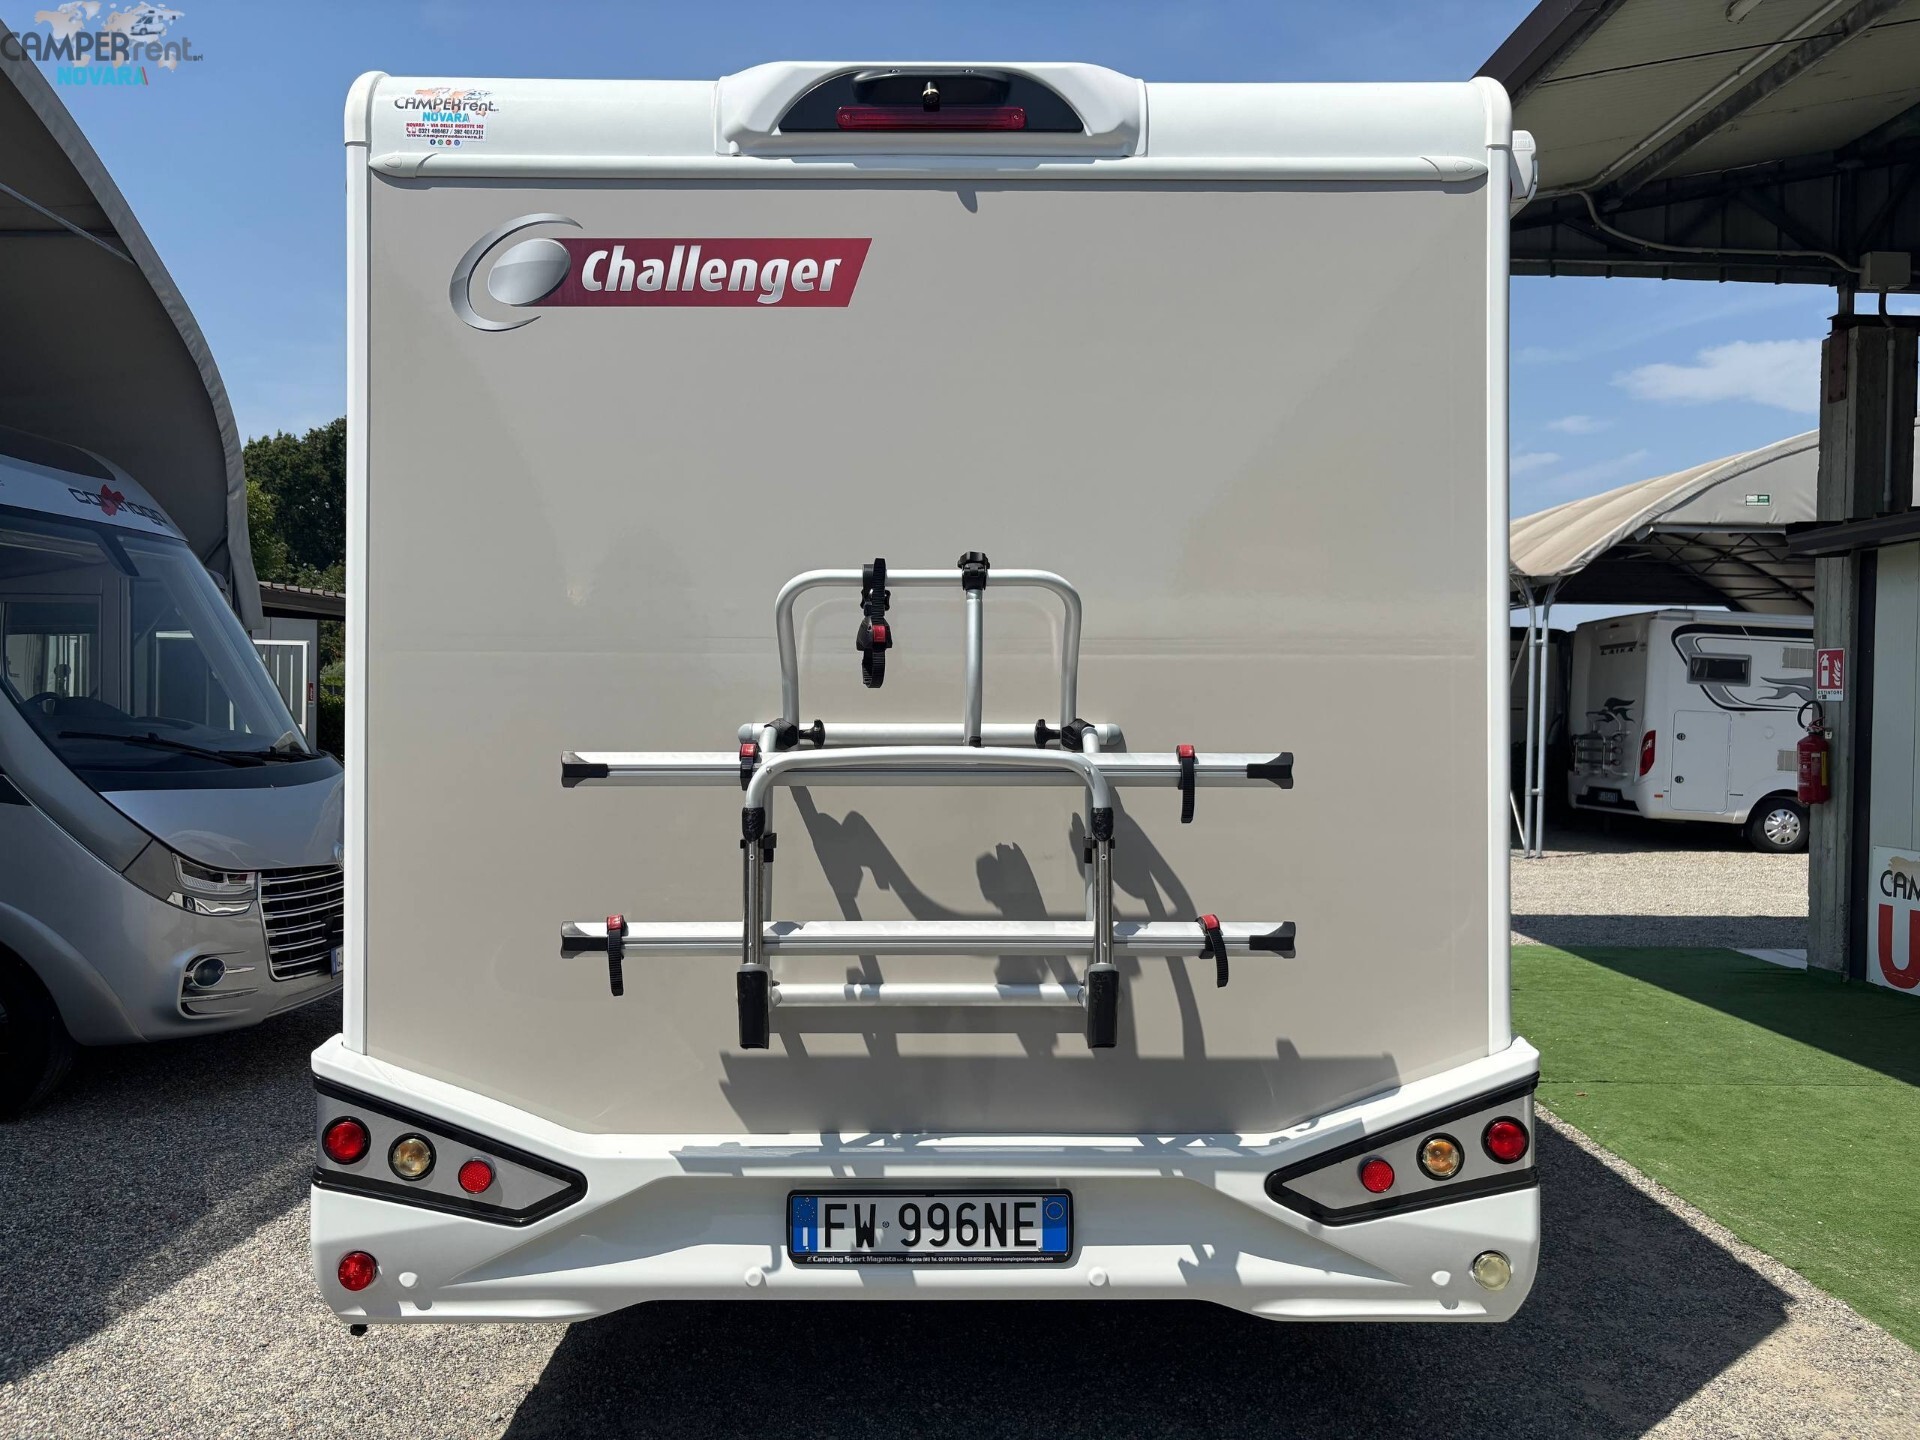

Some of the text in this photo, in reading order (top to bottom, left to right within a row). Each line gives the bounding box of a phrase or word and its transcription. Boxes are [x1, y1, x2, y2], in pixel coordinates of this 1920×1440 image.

[422, 112, 469, 123] NOVARA
[581, 244, 842, 305] Challenger
[1600, 647, 1634, 656] LAIKA
[824, 1203, 877, 1248] FW
[898, 1202, 1037, 1248] 996NE
[813, 1255, 844, 1264] Camping
[844, 1255, 866, 1263] Sport
[866, 1255, 897, 1264] Magenta
